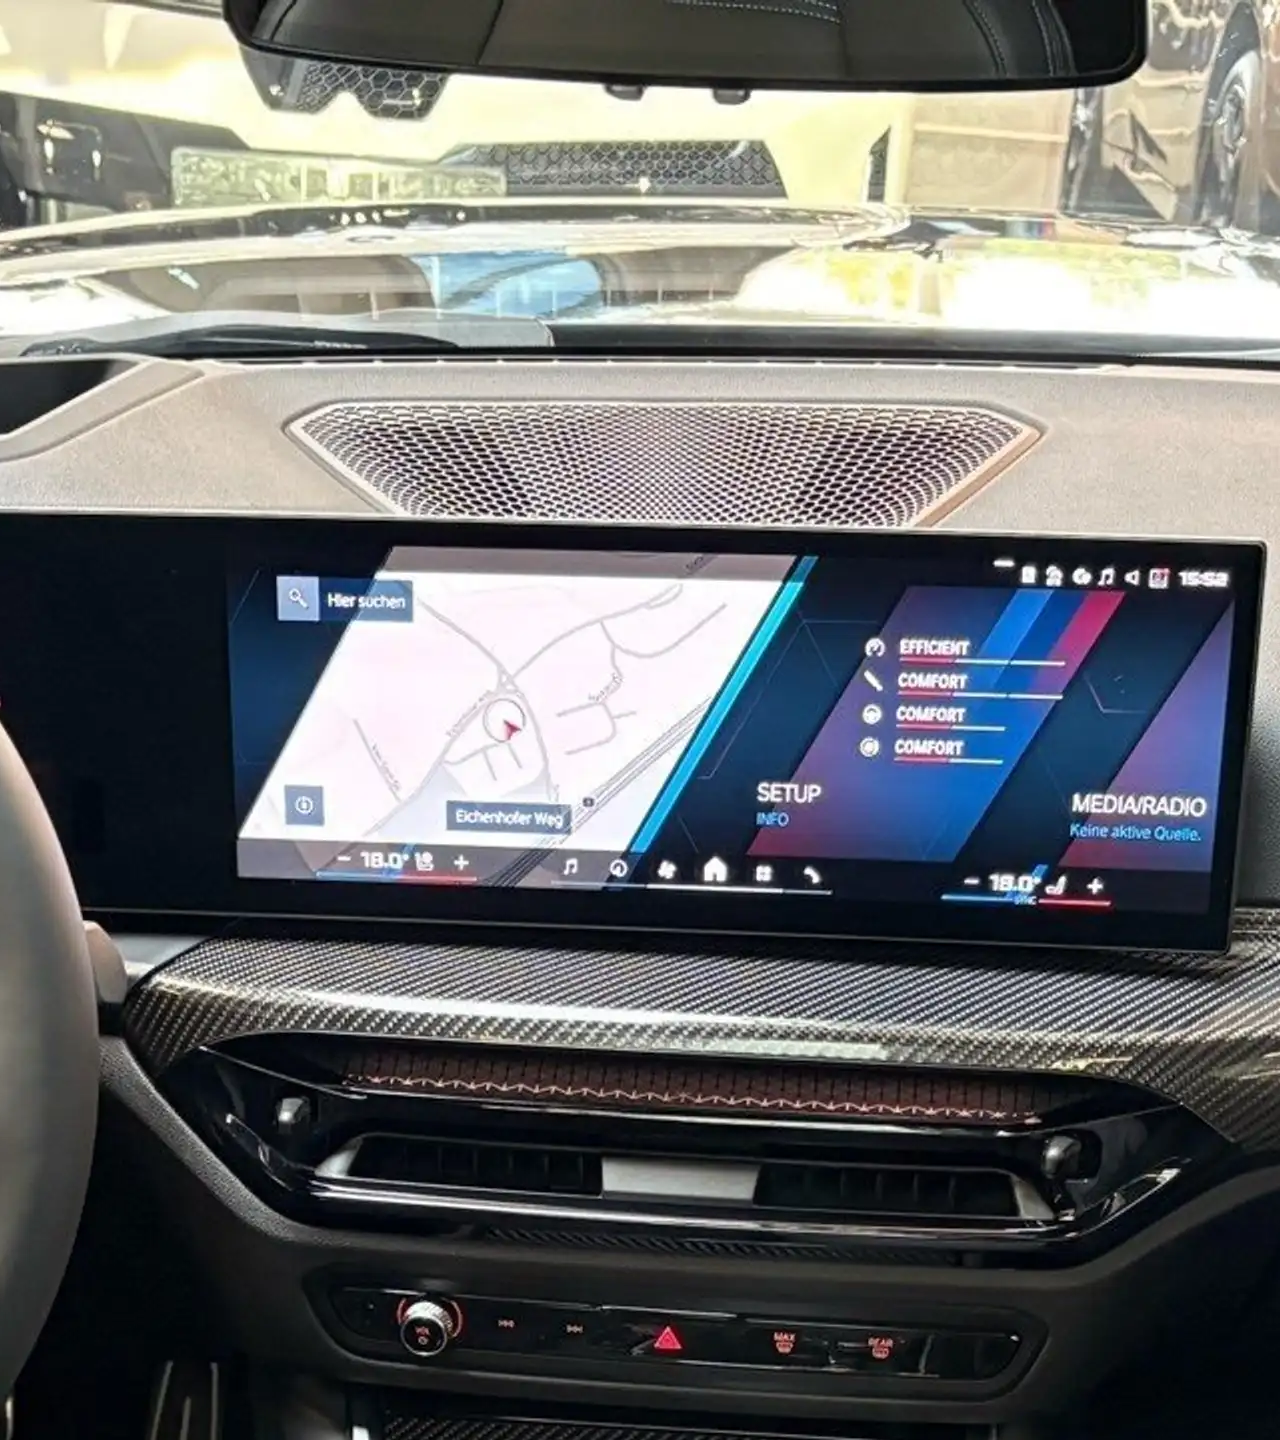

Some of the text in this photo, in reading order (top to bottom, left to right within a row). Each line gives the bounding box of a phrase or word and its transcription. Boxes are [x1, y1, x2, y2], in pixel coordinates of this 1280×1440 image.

[327, 592, 406, 610] Hier suchen
[899, 637, 970, 656] EFFICIENT
[897, 672, 968, 690] COMFORT
[895, 706, 966, 723] COMFORT
[894, 739, 965, 757] COMFORT
[756, 781, 822, 804] SETUP
[1071, 792, 1208, 818] MEDIA/RADIO
[455, 807, 564, 830] Eichenhofer Weg
[1070, 822, 1202, 842] Keine aktive Quelle.
